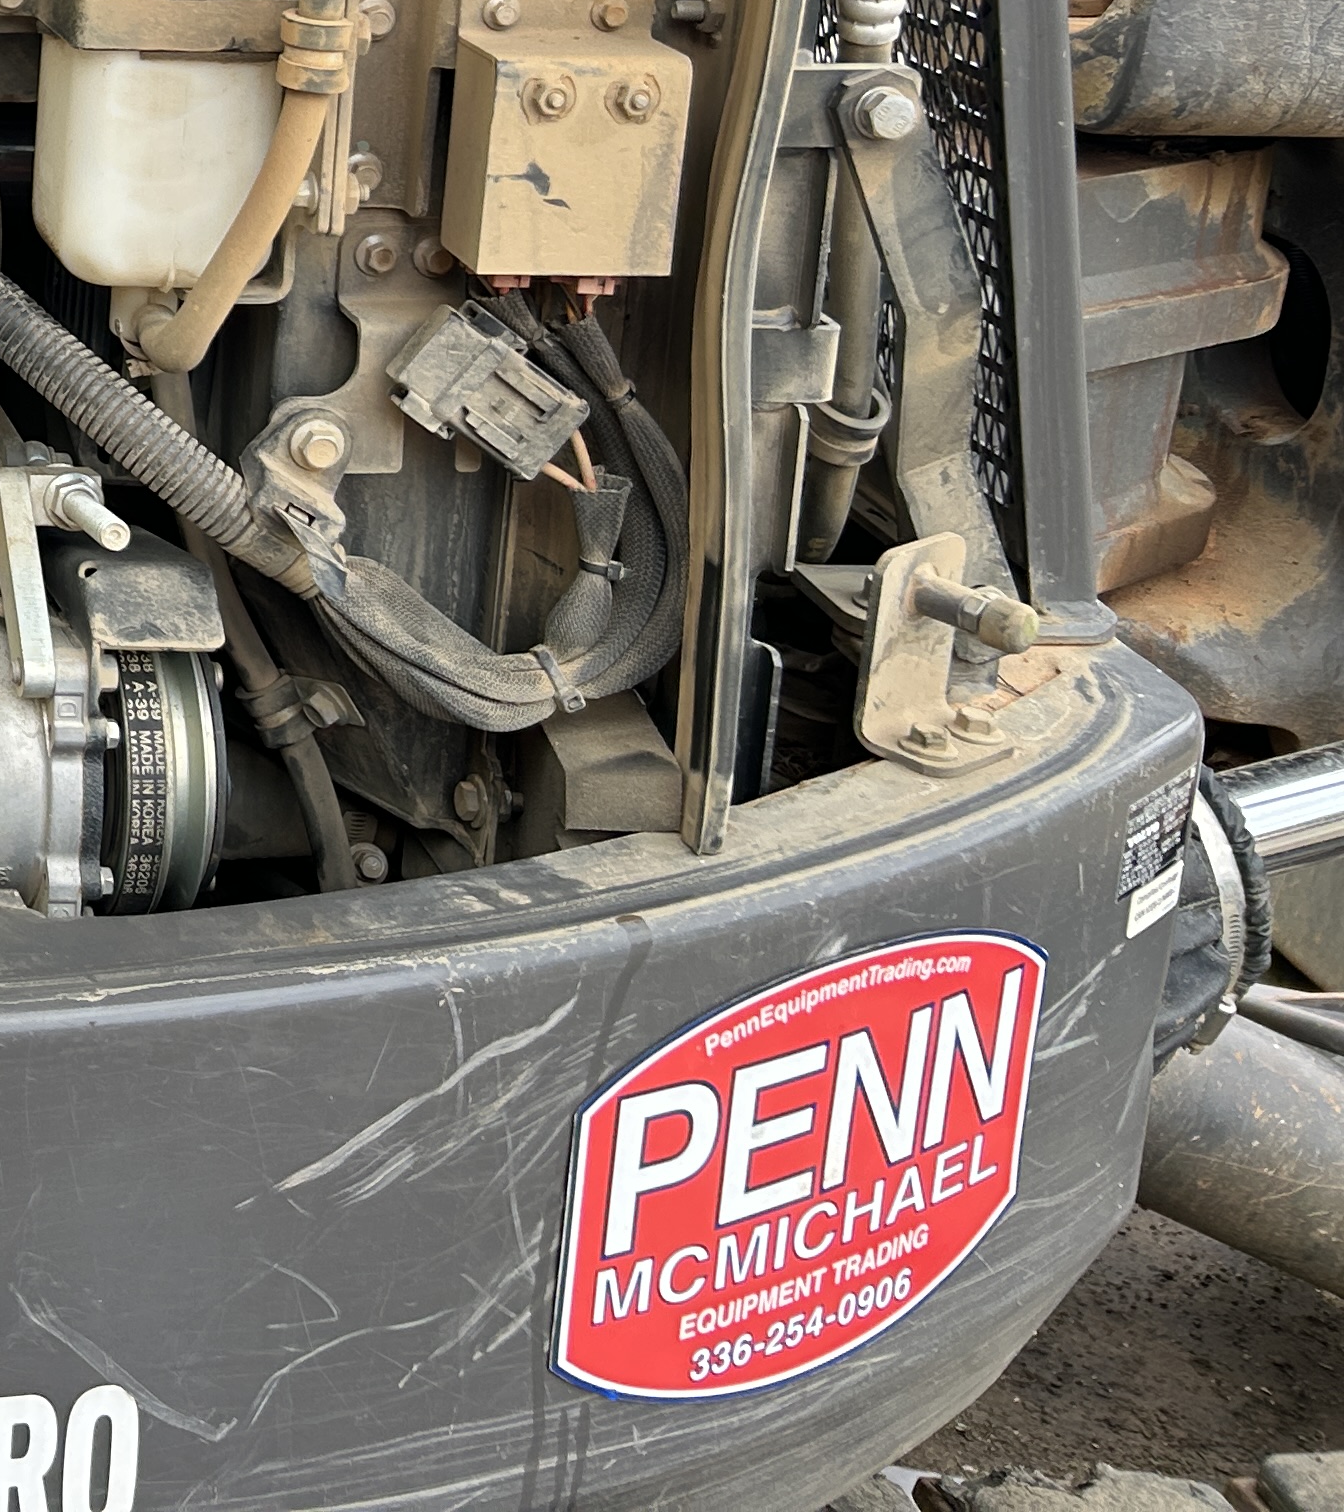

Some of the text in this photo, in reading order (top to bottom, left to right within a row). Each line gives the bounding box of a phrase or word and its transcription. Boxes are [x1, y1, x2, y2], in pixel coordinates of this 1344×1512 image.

[132, 680, 150, 721] A-39
[138, 730, 154, 776] MADE
[142, 779, 155, 795] IN
[141, 799, 155, 846] KOREA
[704, 953, 972, 1057] PennEquipmentTrading.com
[601, 964, 1025, 1259] PENN
[591, 1134, 998, 1327] MCMICHAEL
[678, 1222, 929, 1341] EQUIPMENT TRADING
[688, 1267, 913, 1383] 336-254-0906
